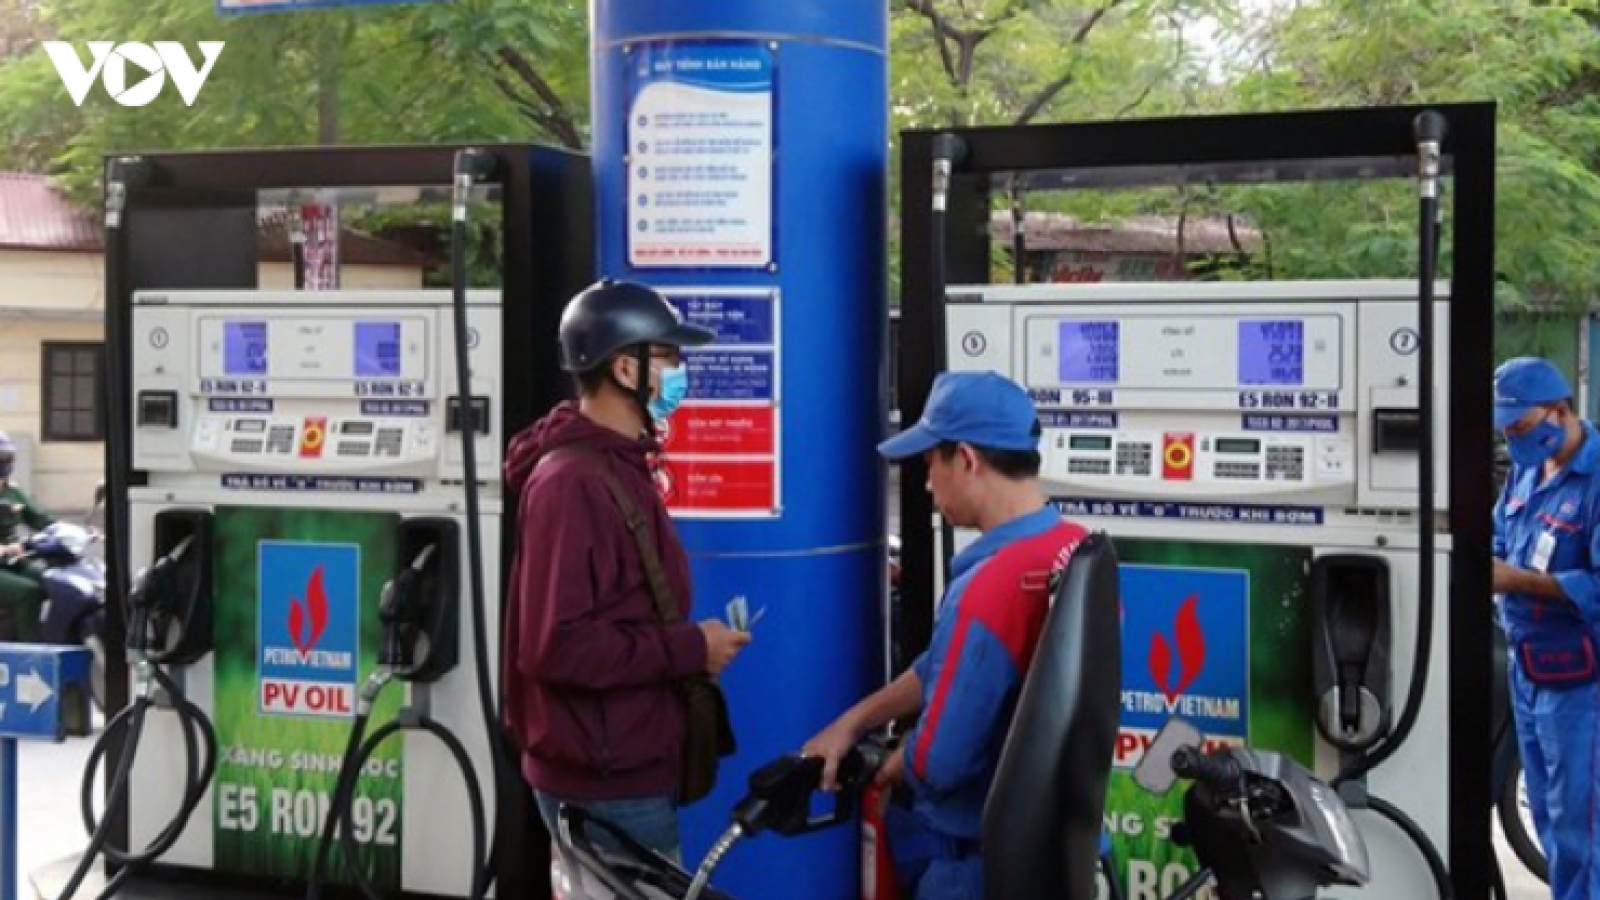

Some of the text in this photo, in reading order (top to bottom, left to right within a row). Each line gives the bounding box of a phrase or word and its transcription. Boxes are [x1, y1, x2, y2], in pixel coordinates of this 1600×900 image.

[263, 682, 351, 713] PV OIL
[291, 750, 343, 771] SINH
[219, 783, 259, 832] E5
[352, 796, 397, 846] 92
